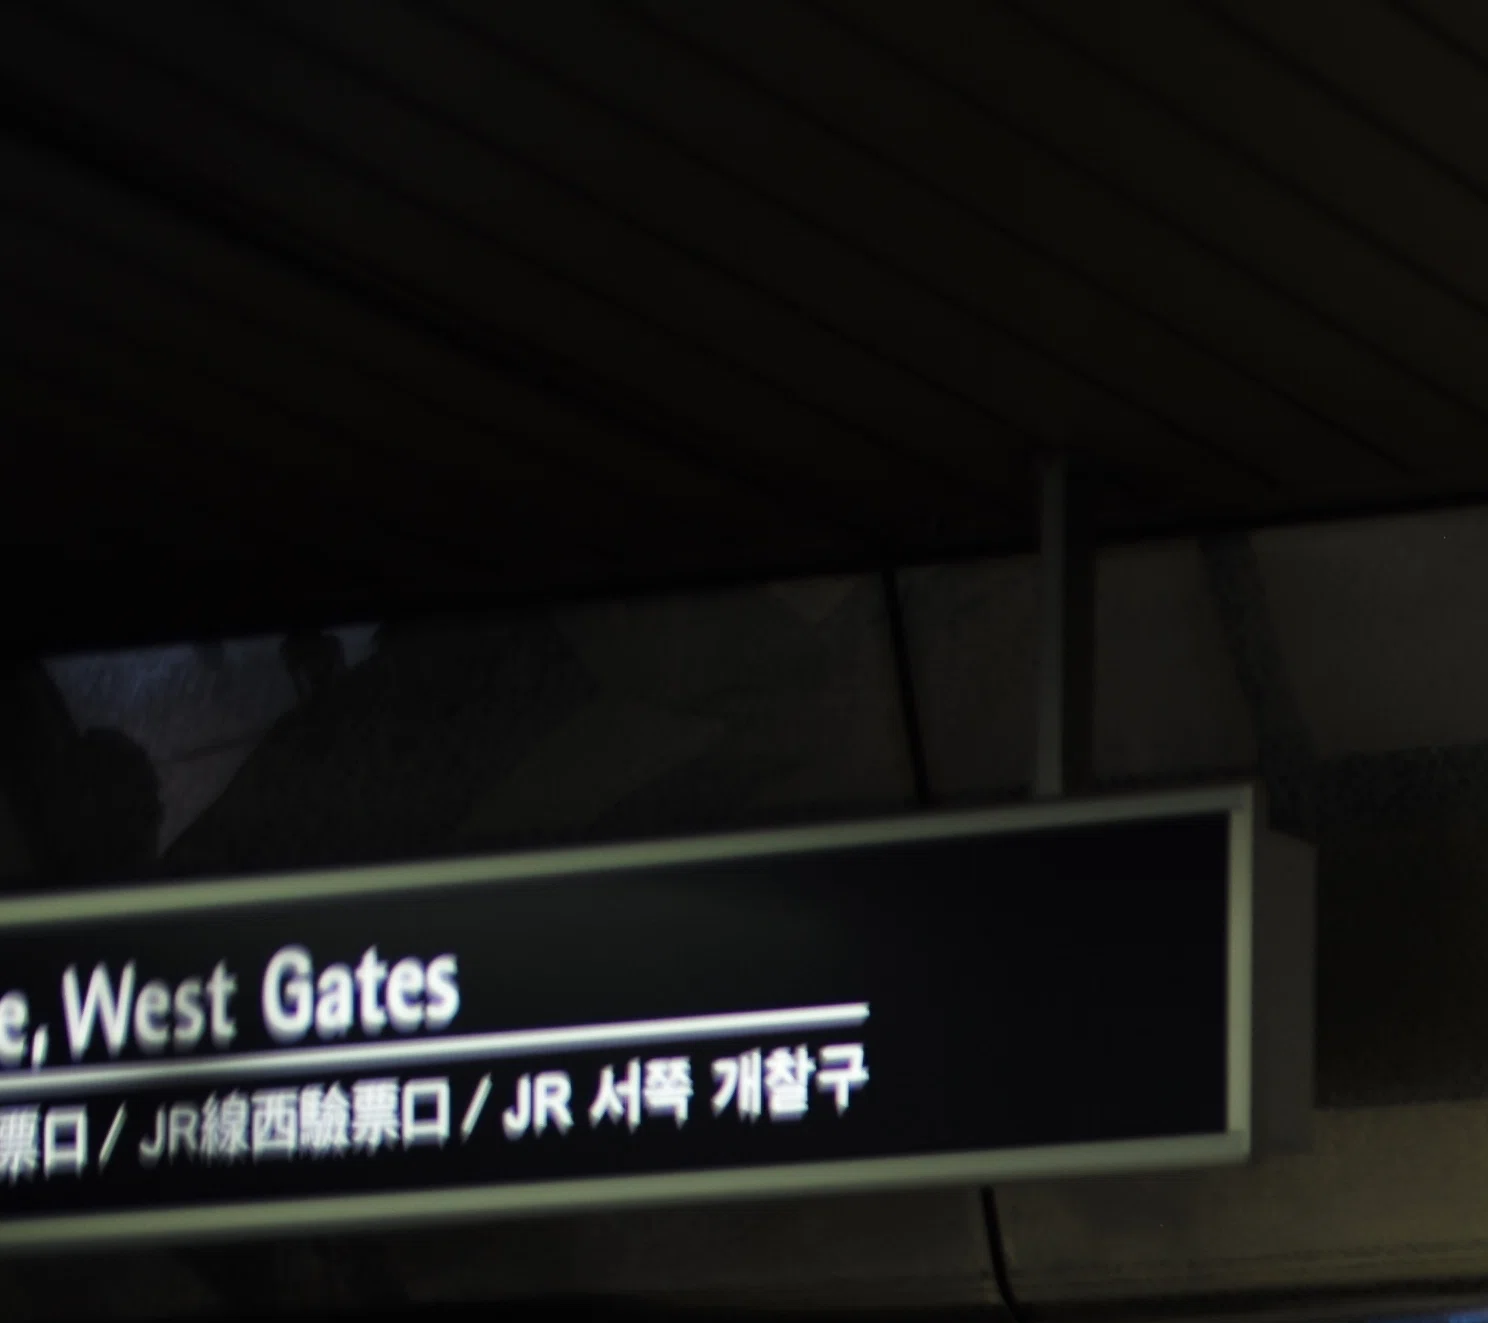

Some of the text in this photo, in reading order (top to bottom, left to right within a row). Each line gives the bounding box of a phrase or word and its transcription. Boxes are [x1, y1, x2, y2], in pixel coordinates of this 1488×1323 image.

[61, 959, 238, 1064] West
[261, 940, 460, 1044] Gates
[502, 1068, 573, 1139] JR
[587, 1052, 694, 1133] 서쪽
[710, 1040, 870, 1121] 개찰구
